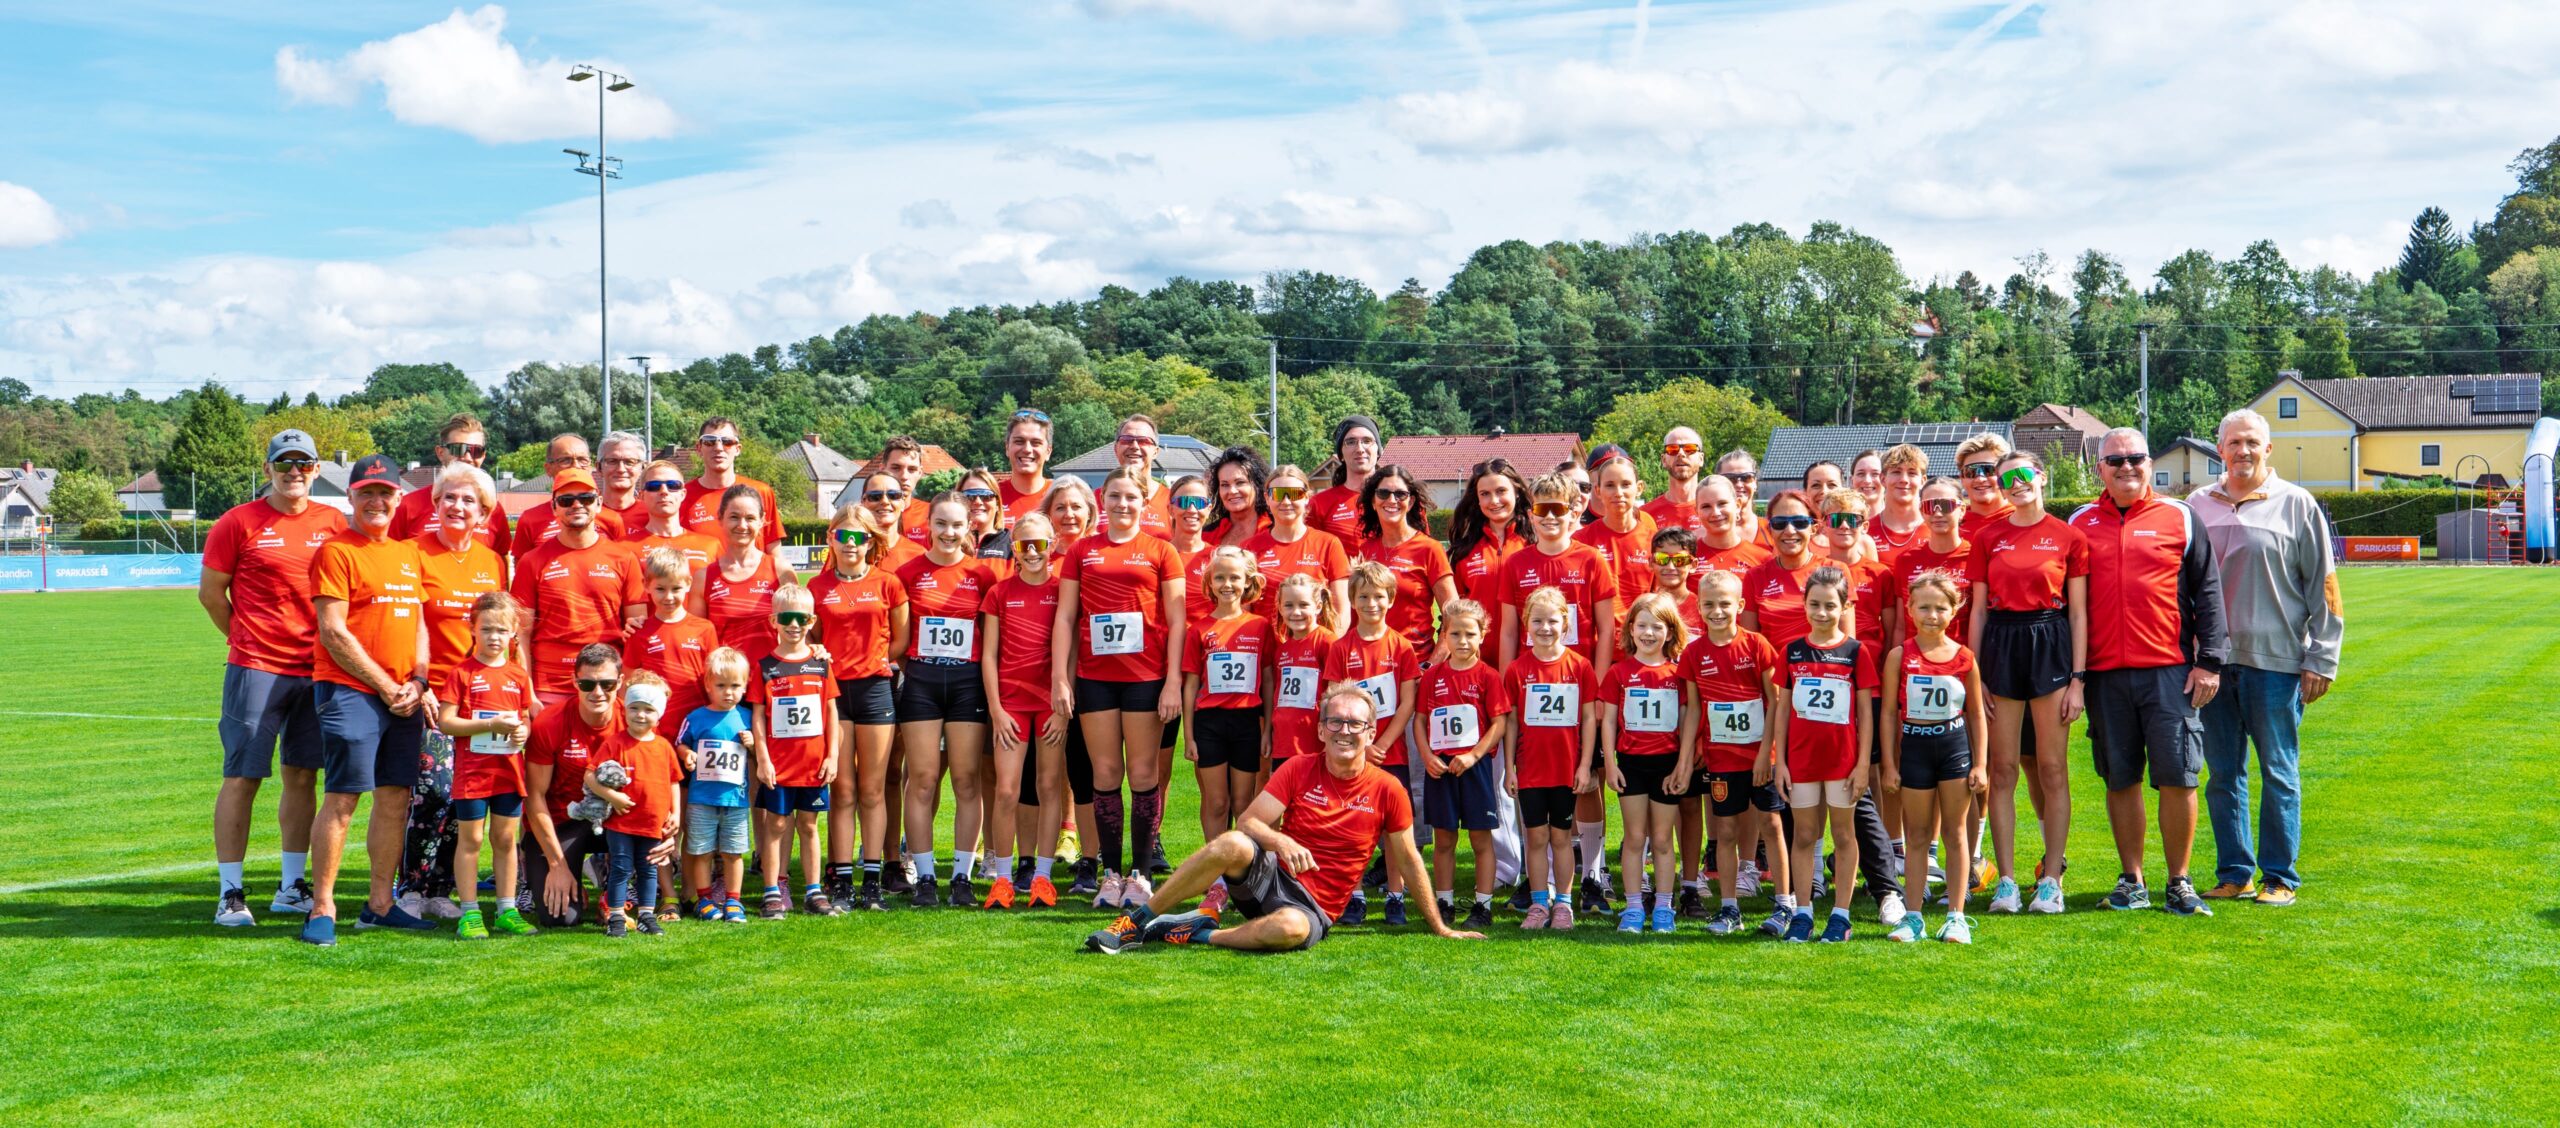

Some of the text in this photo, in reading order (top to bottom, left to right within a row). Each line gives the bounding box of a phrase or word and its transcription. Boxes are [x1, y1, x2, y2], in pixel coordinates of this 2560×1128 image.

[2354, 544, 2401, 552] SPARKASSE
[56, 568, 100, 577] SPARKASSE
[129, 567, 182, 577] #glaubandich
[929, 627, 964, 646] 130
[1103, 624, 1126, 642] 97
[1221, 662, 1245, 681] 32
[1283, 678, 1301, 696] 28
[1366, 686, 1385, 705] 1
[1540, 695, 1565, 714] 24
[1807, 688, 1835, 709] 23
[1921, 687, 1948, 707] 70
[787, 706, 811, 725] 52
[1639, 700, 1661, 719] 11
[1441, 715, 1463, 736] 16
[1725, 713, 1750, 731] 48
[1911, 725, 1945, 736] PRO
[704, 750, 739, 771] 248
[1356, 795, 1369, 803] LC
